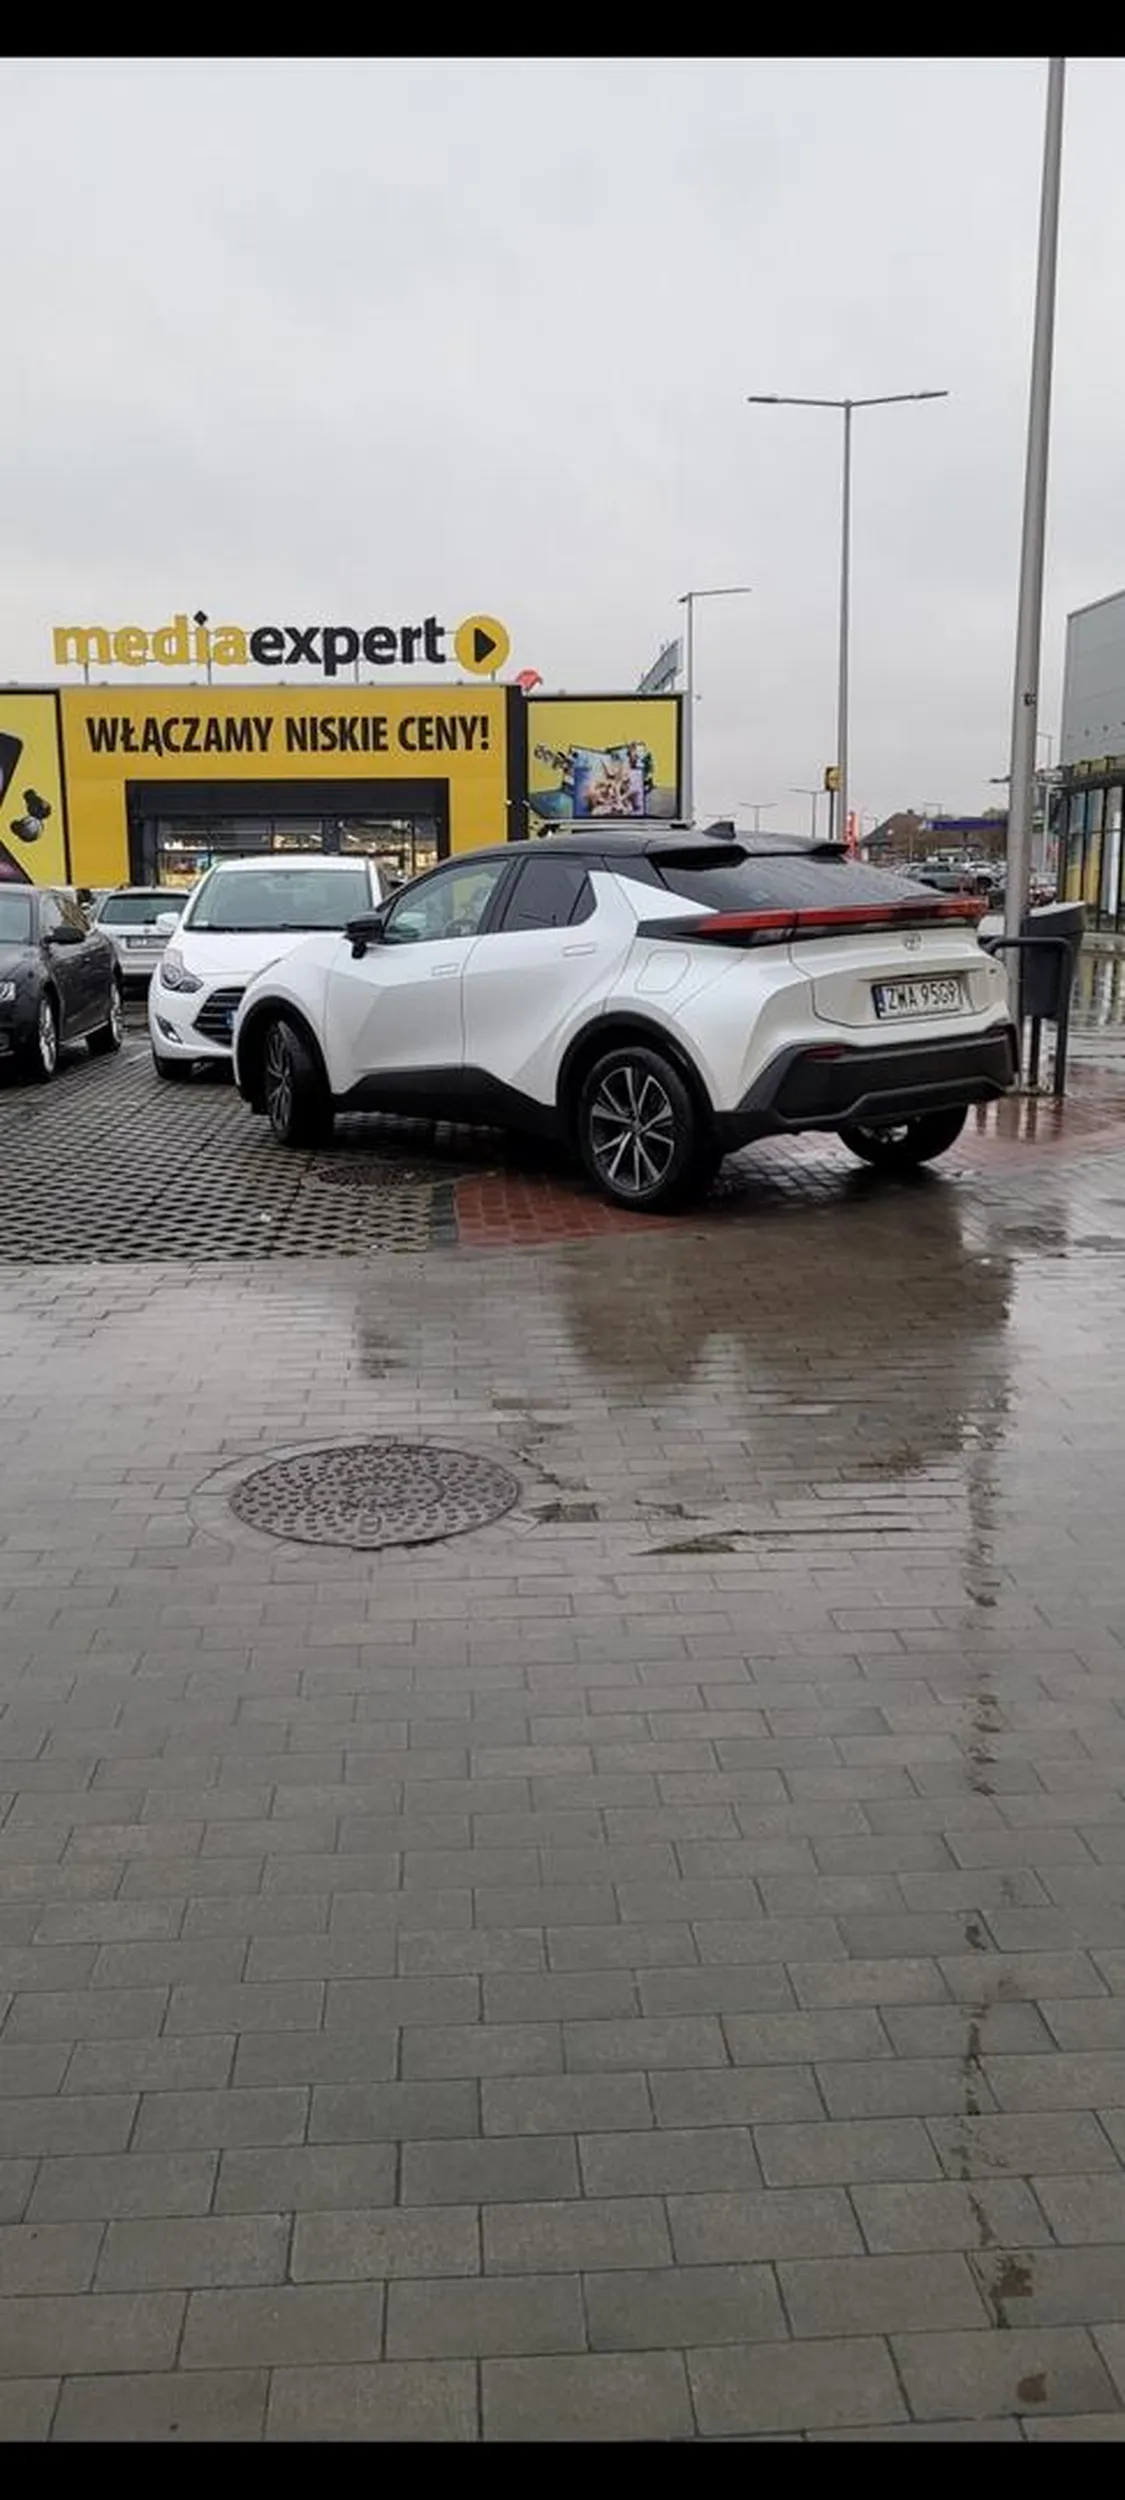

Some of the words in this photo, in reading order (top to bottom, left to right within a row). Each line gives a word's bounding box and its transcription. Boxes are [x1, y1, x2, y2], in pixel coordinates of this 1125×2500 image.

[53, 611, 446, 676] mediaexpert
[86, 716, 274, 757] WŁĄCZAMY
[285, 716, 388, 753] NISKIE
[398, 715, 490, 752] CENY!
[886, 984, 918, 1010] ZWA
